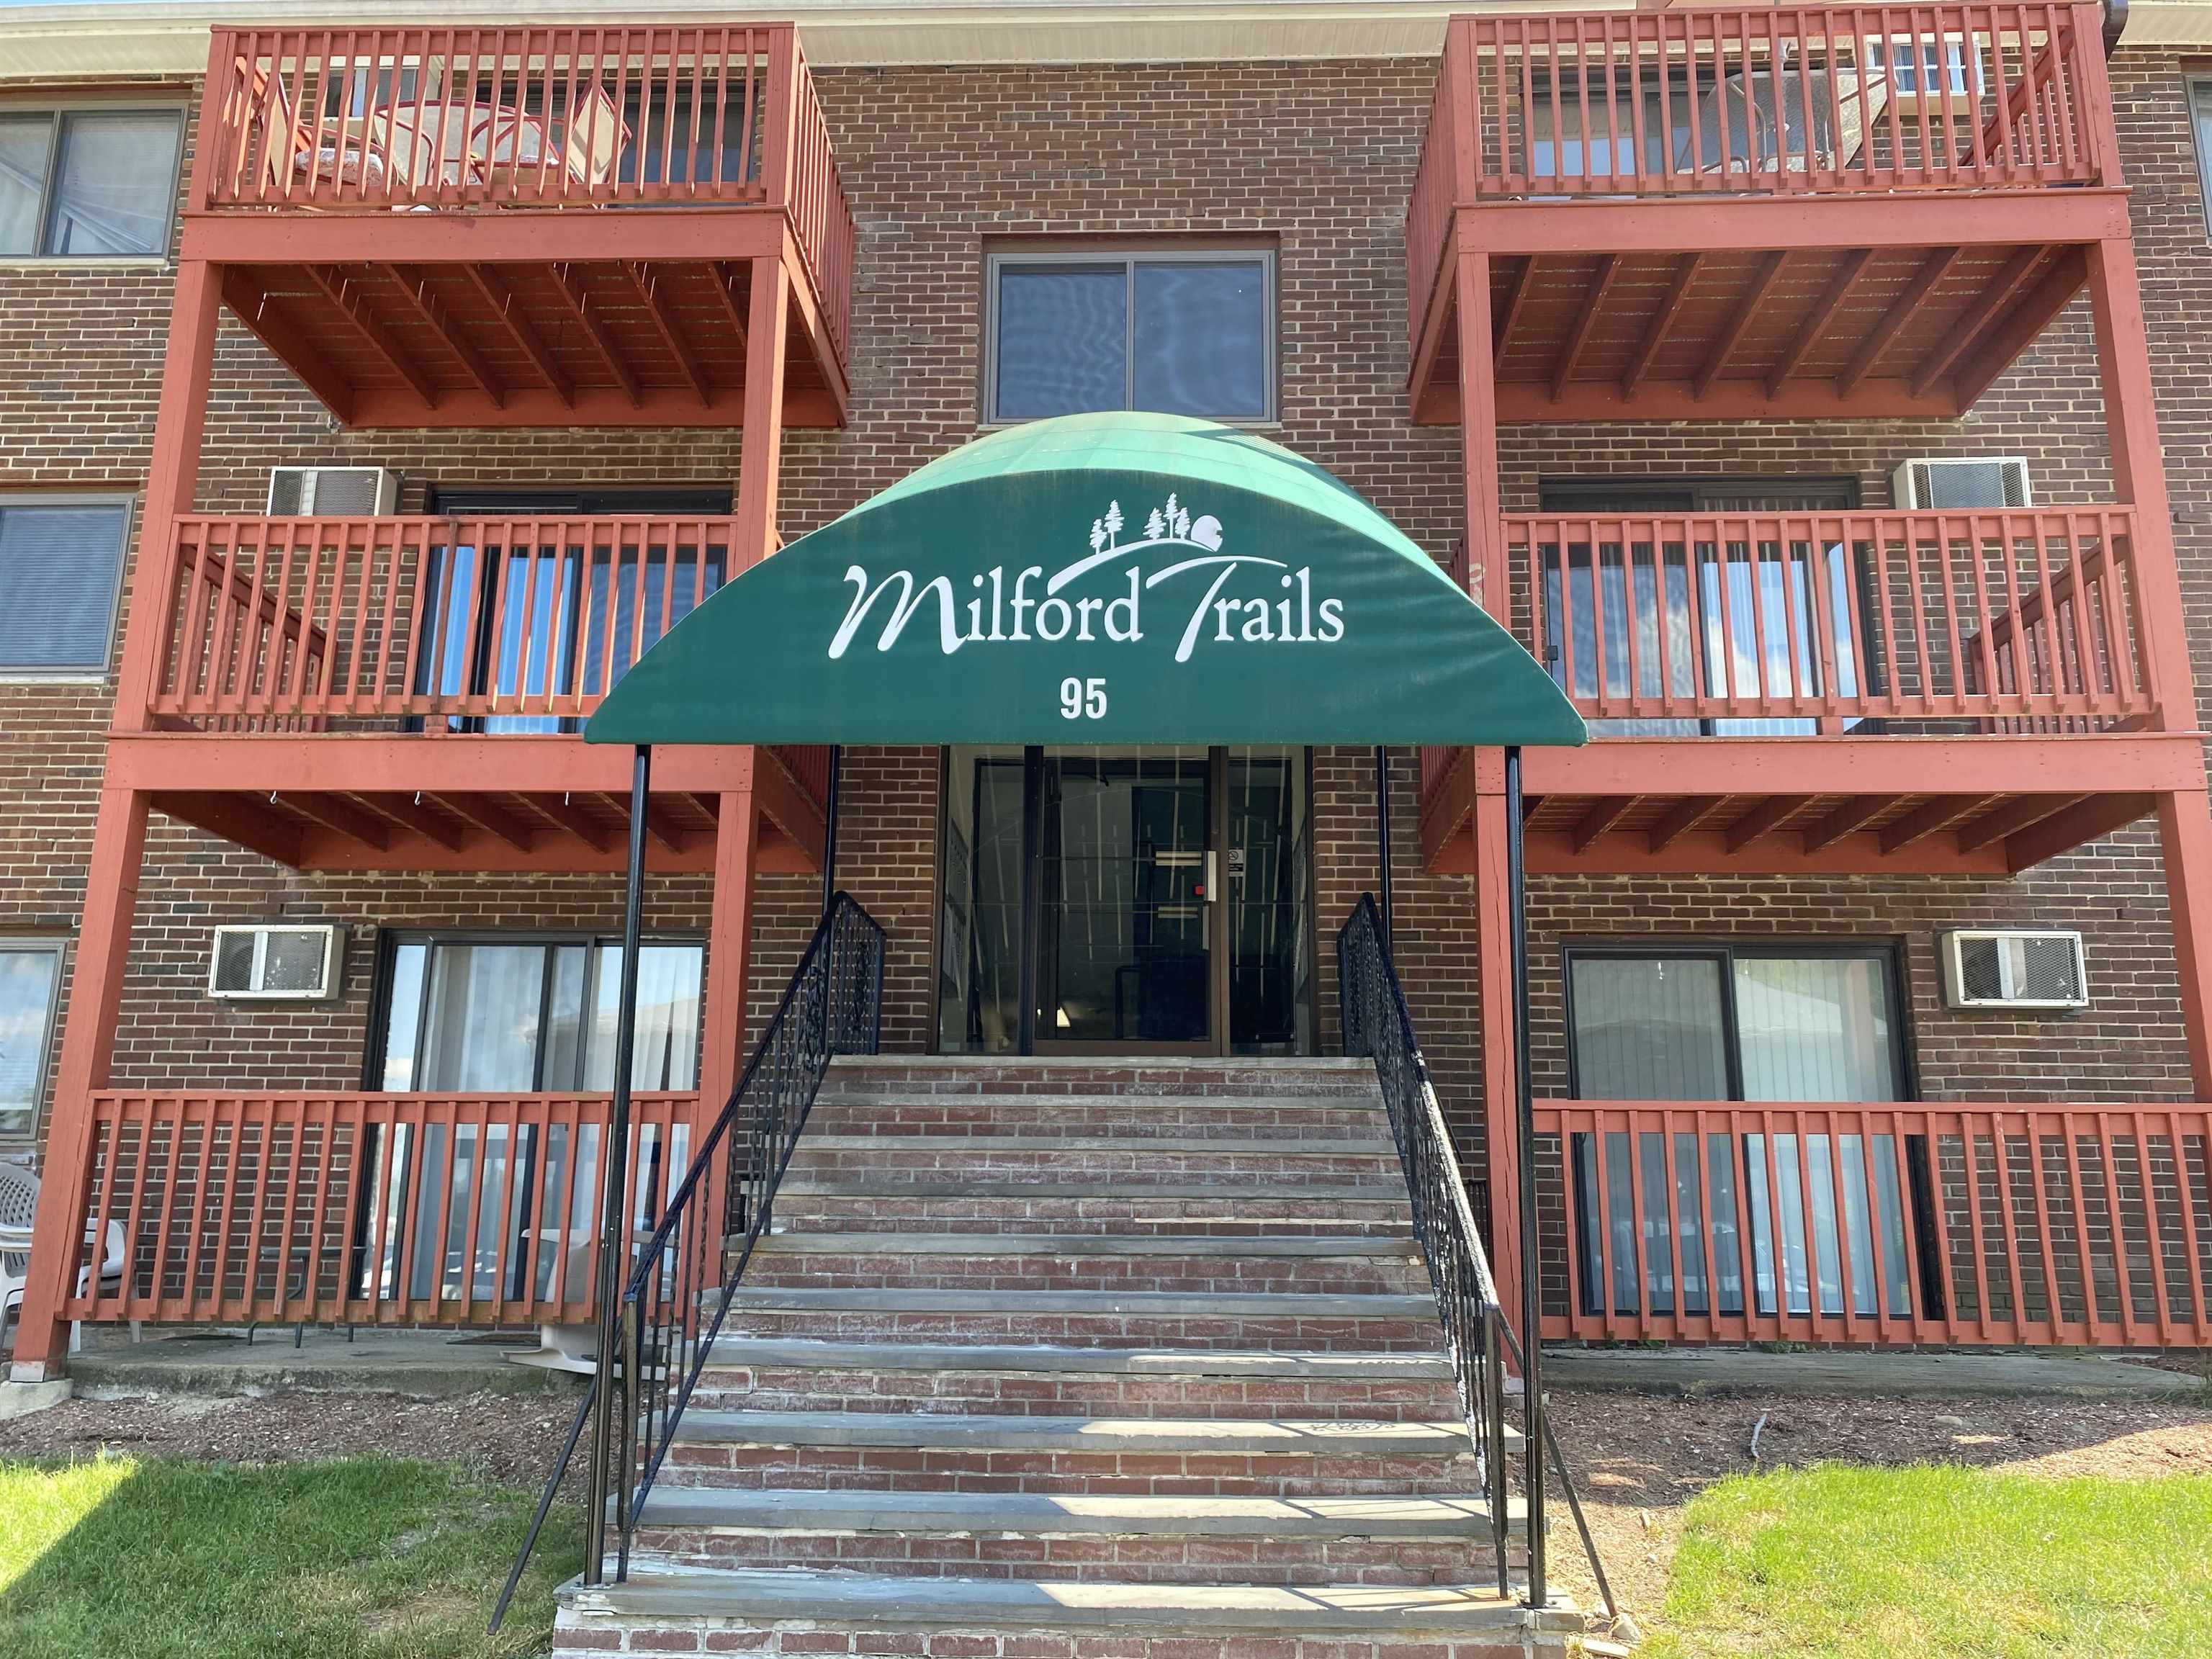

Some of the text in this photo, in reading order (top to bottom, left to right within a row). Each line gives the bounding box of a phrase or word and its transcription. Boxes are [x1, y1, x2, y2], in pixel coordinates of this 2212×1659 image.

[828, 554, 1345, 662] Milford Trails
[1060, 676, 1107, 719] 95
